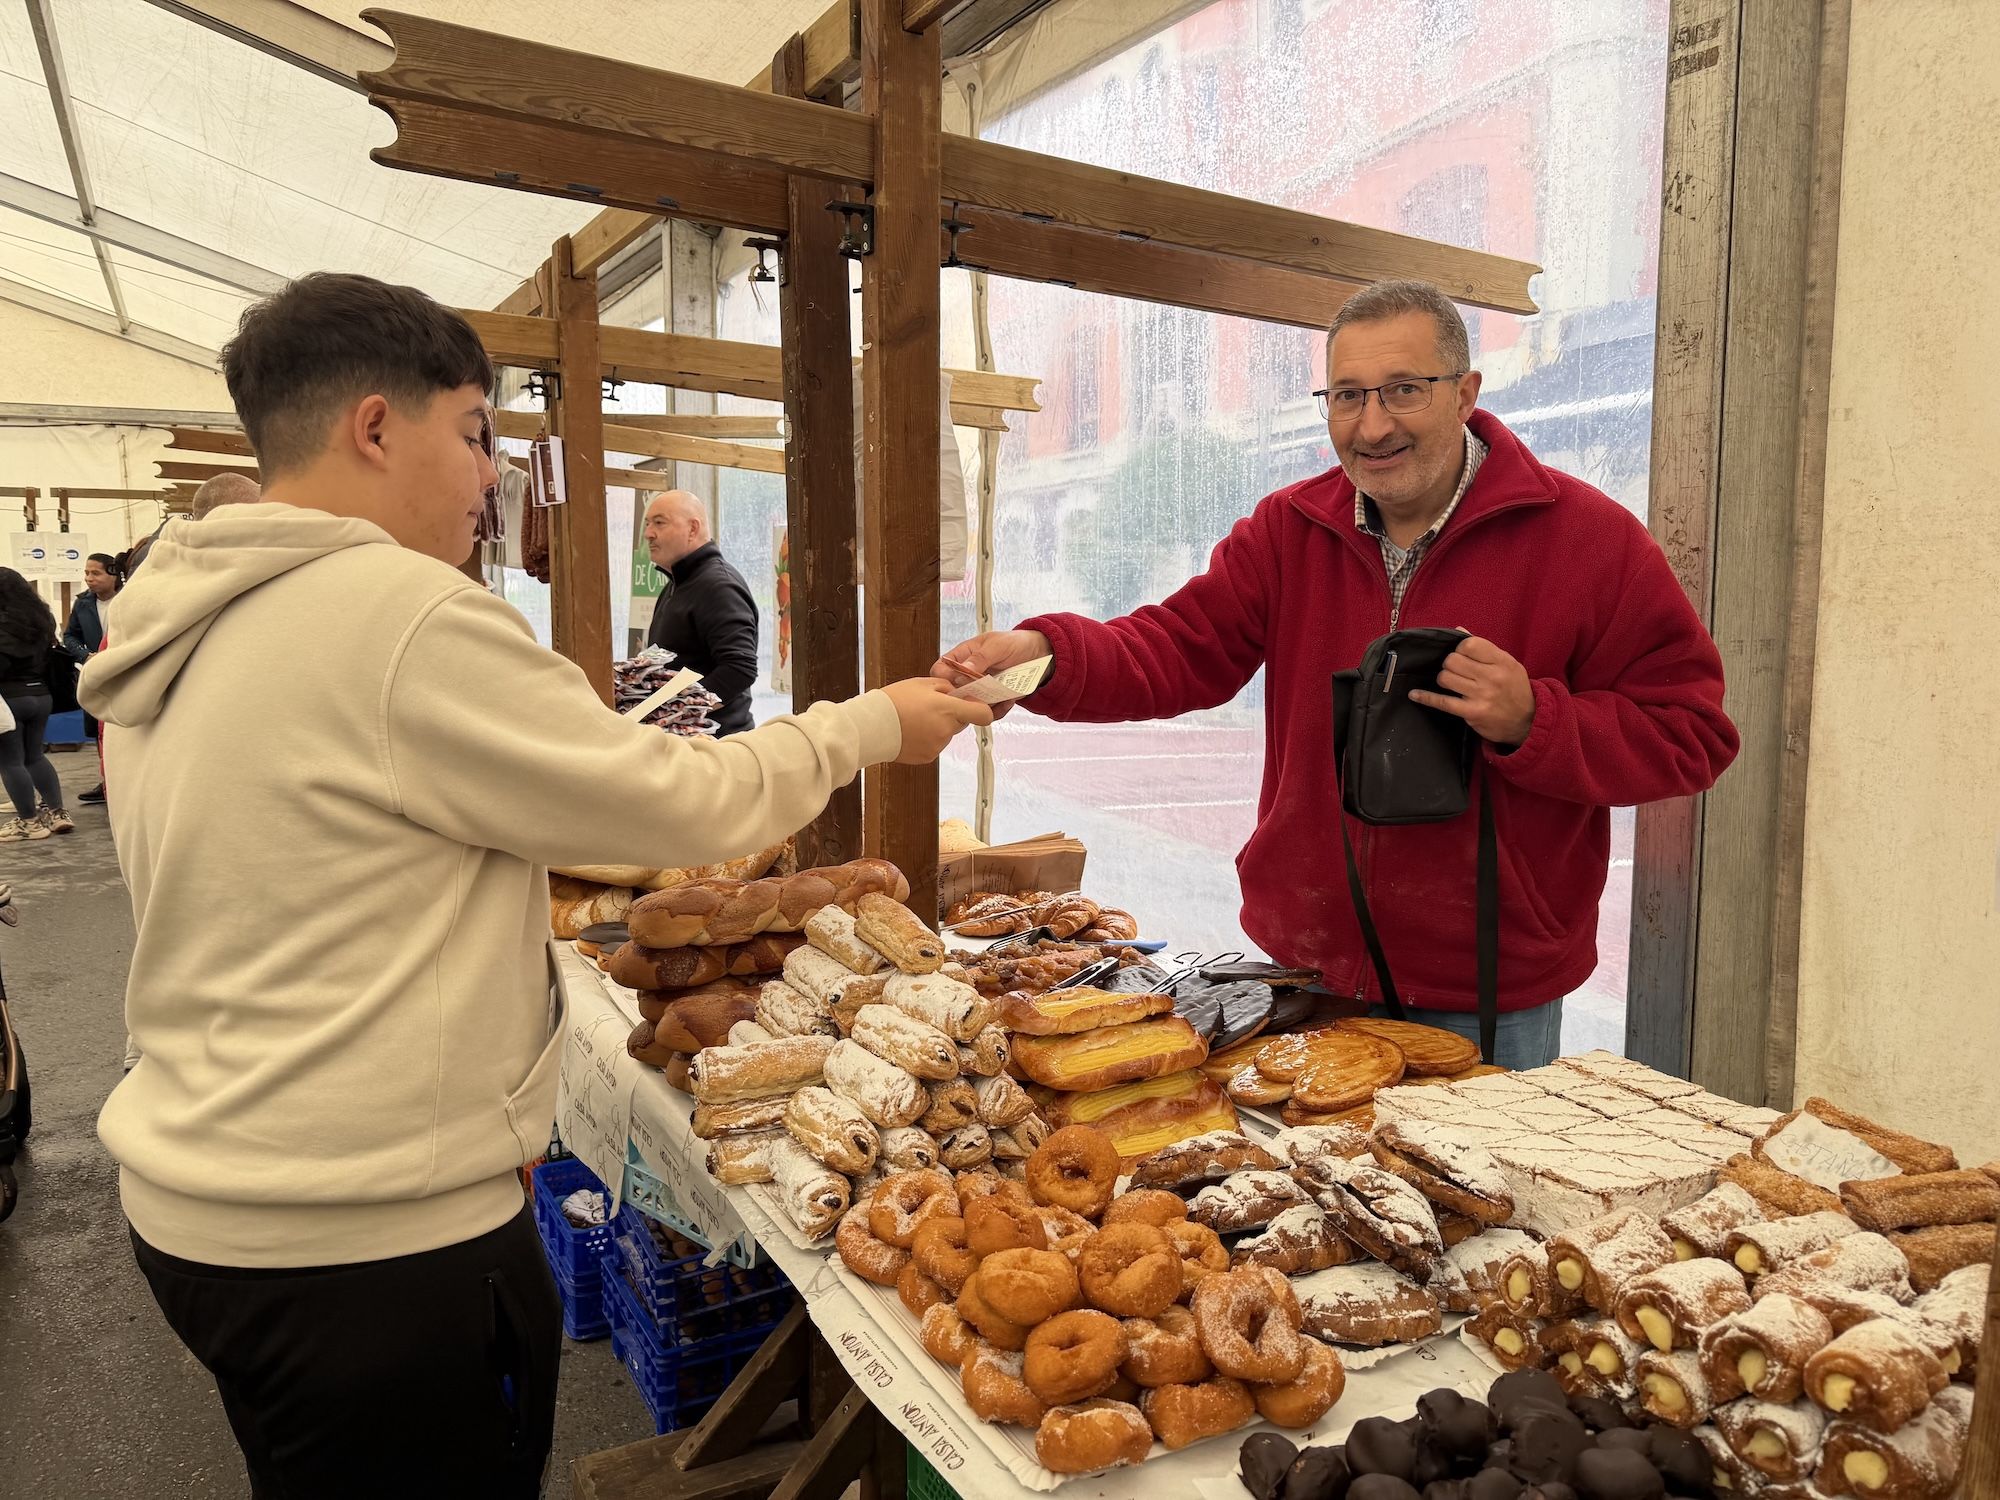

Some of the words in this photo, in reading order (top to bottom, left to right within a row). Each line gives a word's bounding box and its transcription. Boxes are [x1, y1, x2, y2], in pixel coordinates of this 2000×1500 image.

[634, 564, 647, 586] DE
[837, 1330, 872, 1361] ANTON
[863, 1358, 894, 1389] CASA
[899, 1400, 938, 1439] ANTON
[930, 1434, 966, 1471] CASA
